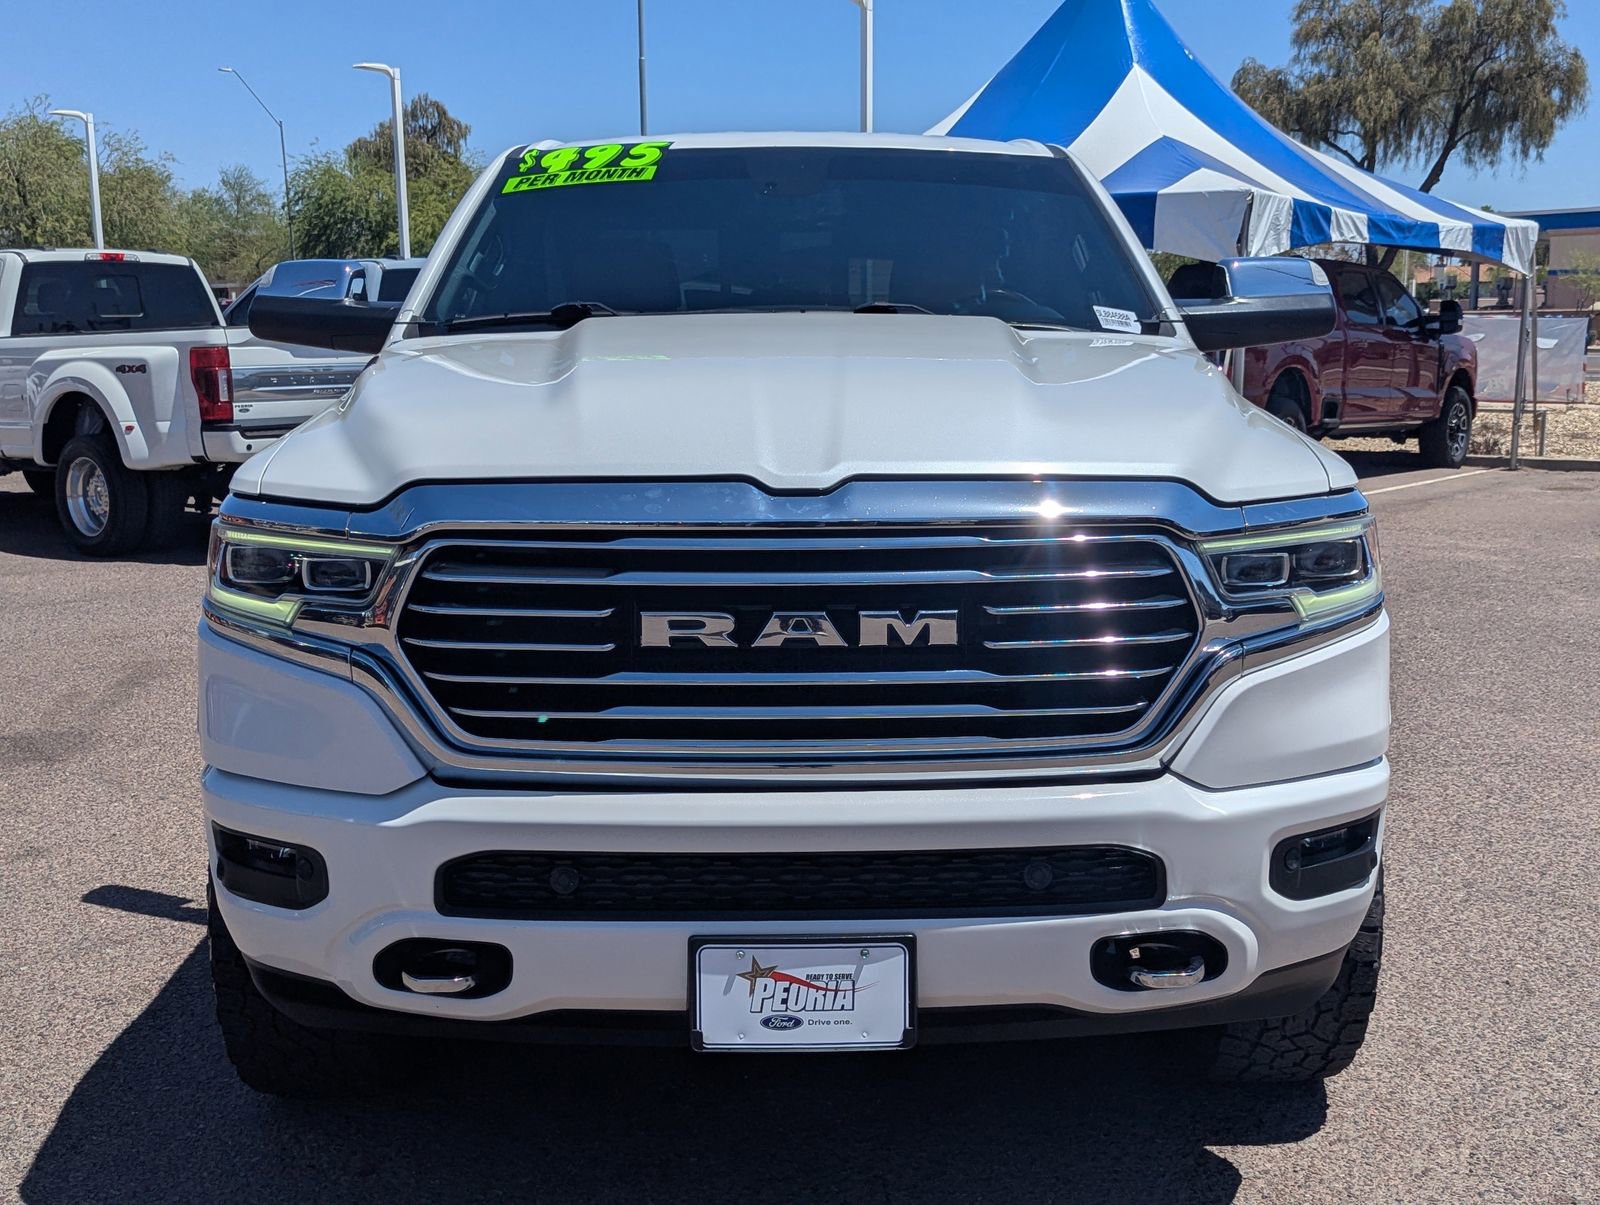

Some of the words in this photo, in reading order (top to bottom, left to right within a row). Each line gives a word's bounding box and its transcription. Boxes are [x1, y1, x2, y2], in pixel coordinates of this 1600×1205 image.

[517, 141, 673, 173] $495
[512, 173, 558, 190] PER
[563, 166, 646, 183] MONTH
[639, 610, 959, 648] RAM
[805, 973, 824, 981] READY
[826, 973, 833, 981] TO
[749, 977, 856, 1014] PEORIA
[768, 1017, 796, 1029] Ford
[807, 1018, 831, 1026] Drive
[833, 1018, 853, 1026] one.
